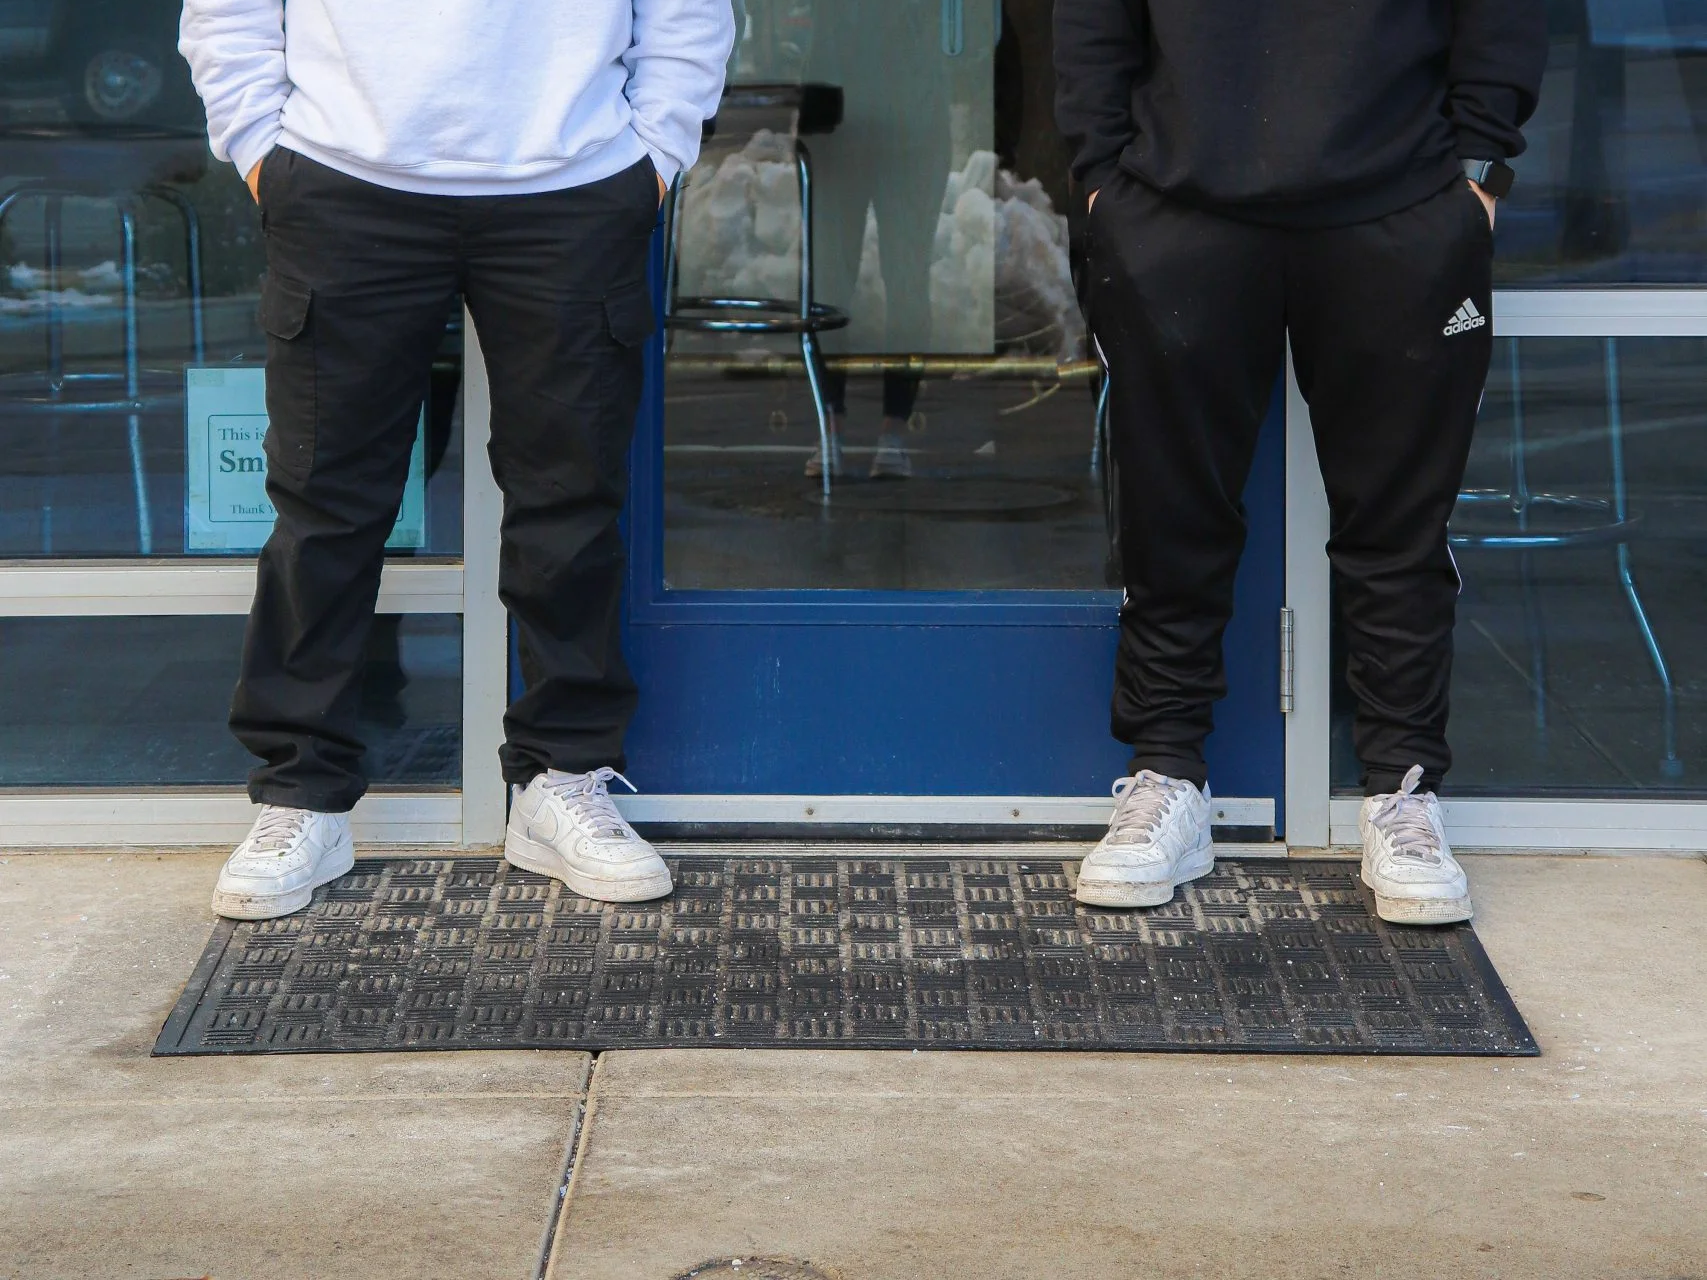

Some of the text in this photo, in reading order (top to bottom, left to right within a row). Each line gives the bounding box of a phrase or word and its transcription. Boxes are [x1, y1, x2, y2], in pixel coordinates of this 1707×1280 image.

[1443, 316, 1485, 336] adidas
[217, 427, 265, 441] This is
[229, 504, 265, 515] Thank
